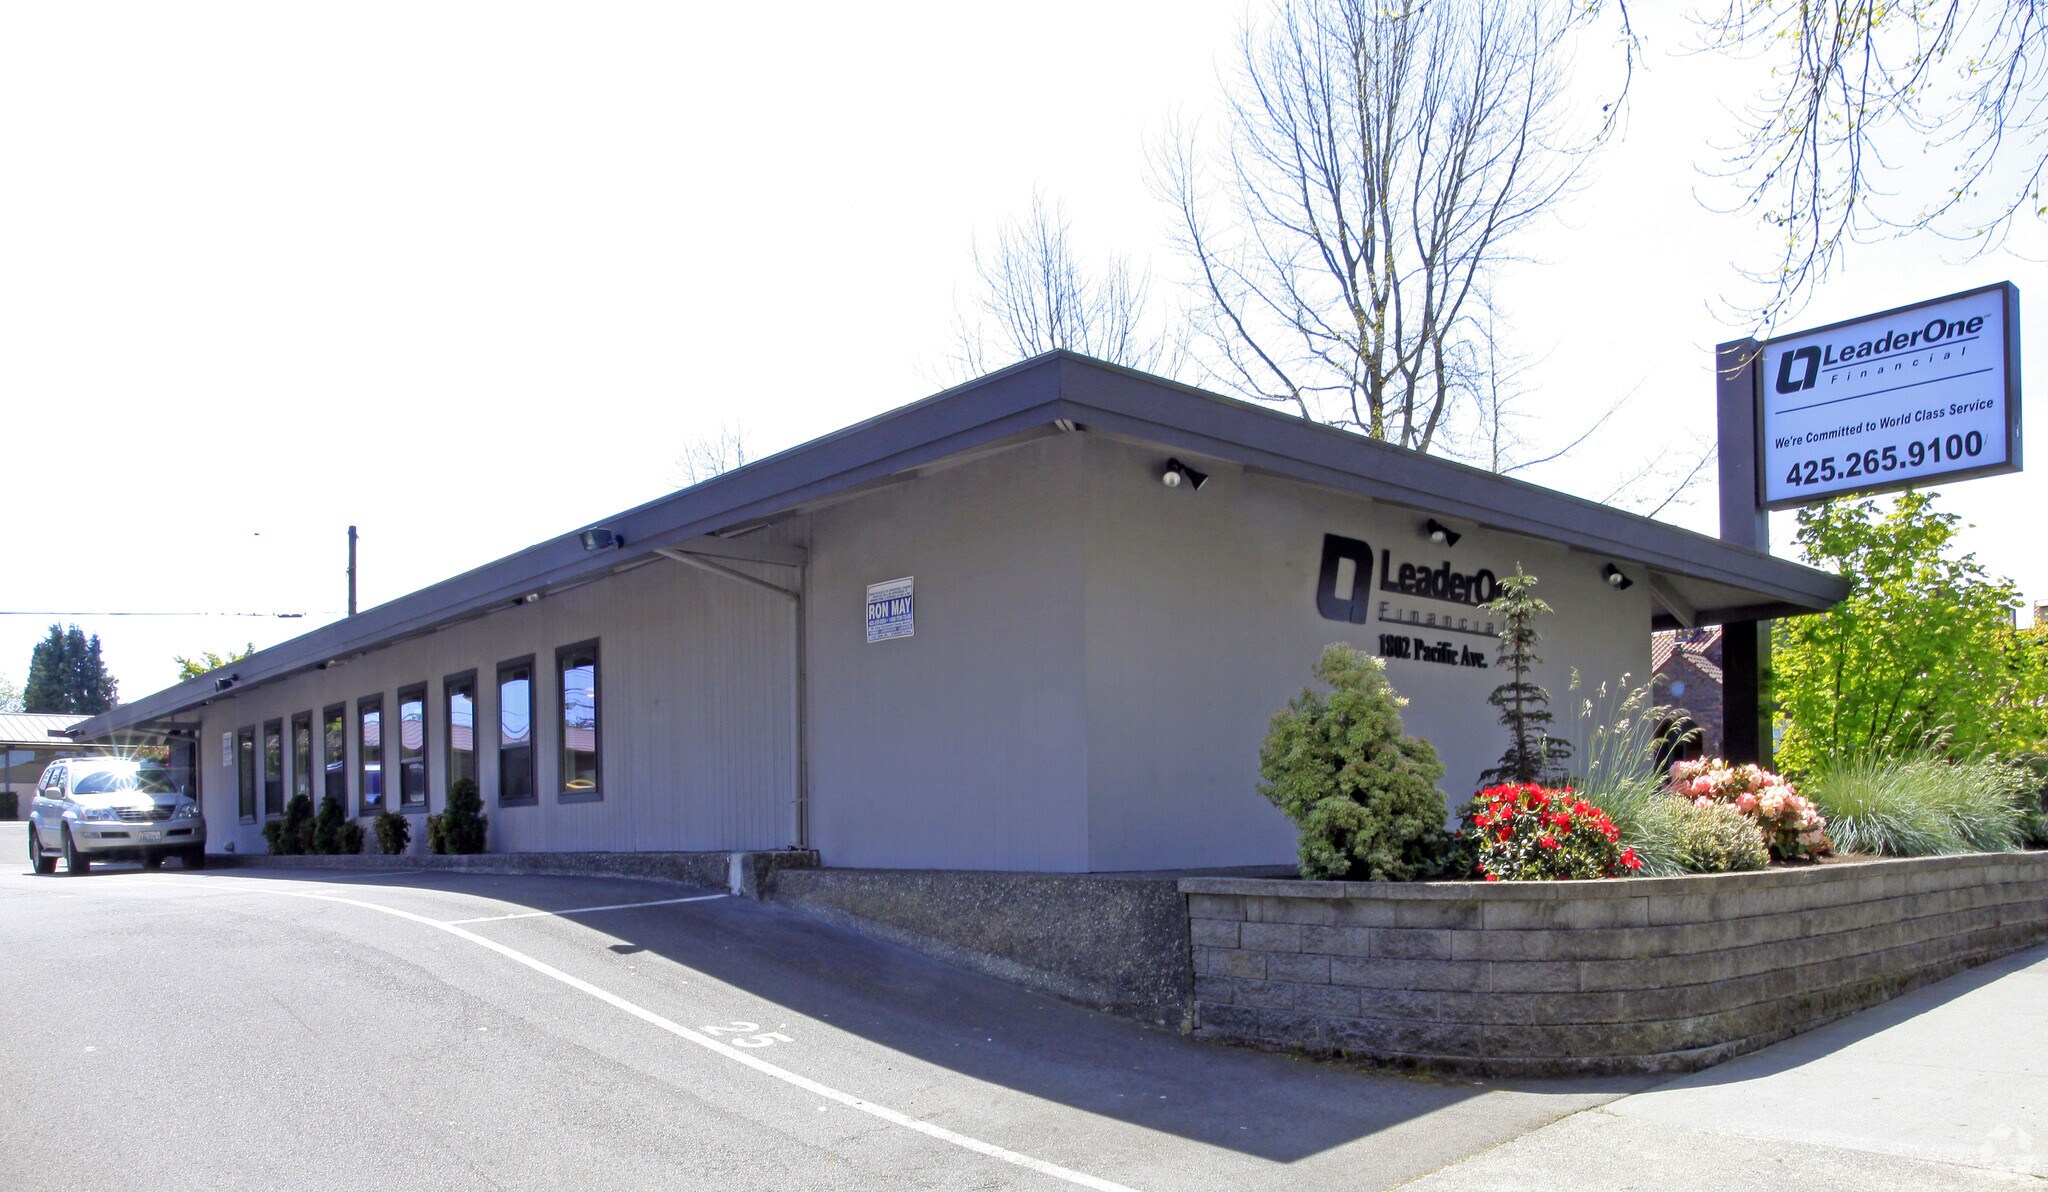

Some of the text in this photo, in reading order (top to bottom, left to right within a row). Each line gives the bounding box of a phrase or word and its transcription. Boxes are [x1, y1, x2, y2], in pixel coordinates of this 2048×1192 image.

[1823, 315, 1984, 366] LeaderOne
[1831, 346, 1966, 384] Financial
[1775, 399, 1994, 449] We're Committed to World Class Service
[1786, 430, 1983, 487] 425.265.9100
[1380, 549, 1513, 606] LeaderO
[869, 596, 911, 621] RON MAY
[1379, 633, 1488, 669] 1802 Pacific Ave.
[700, 1020, 795, 1048] 25
